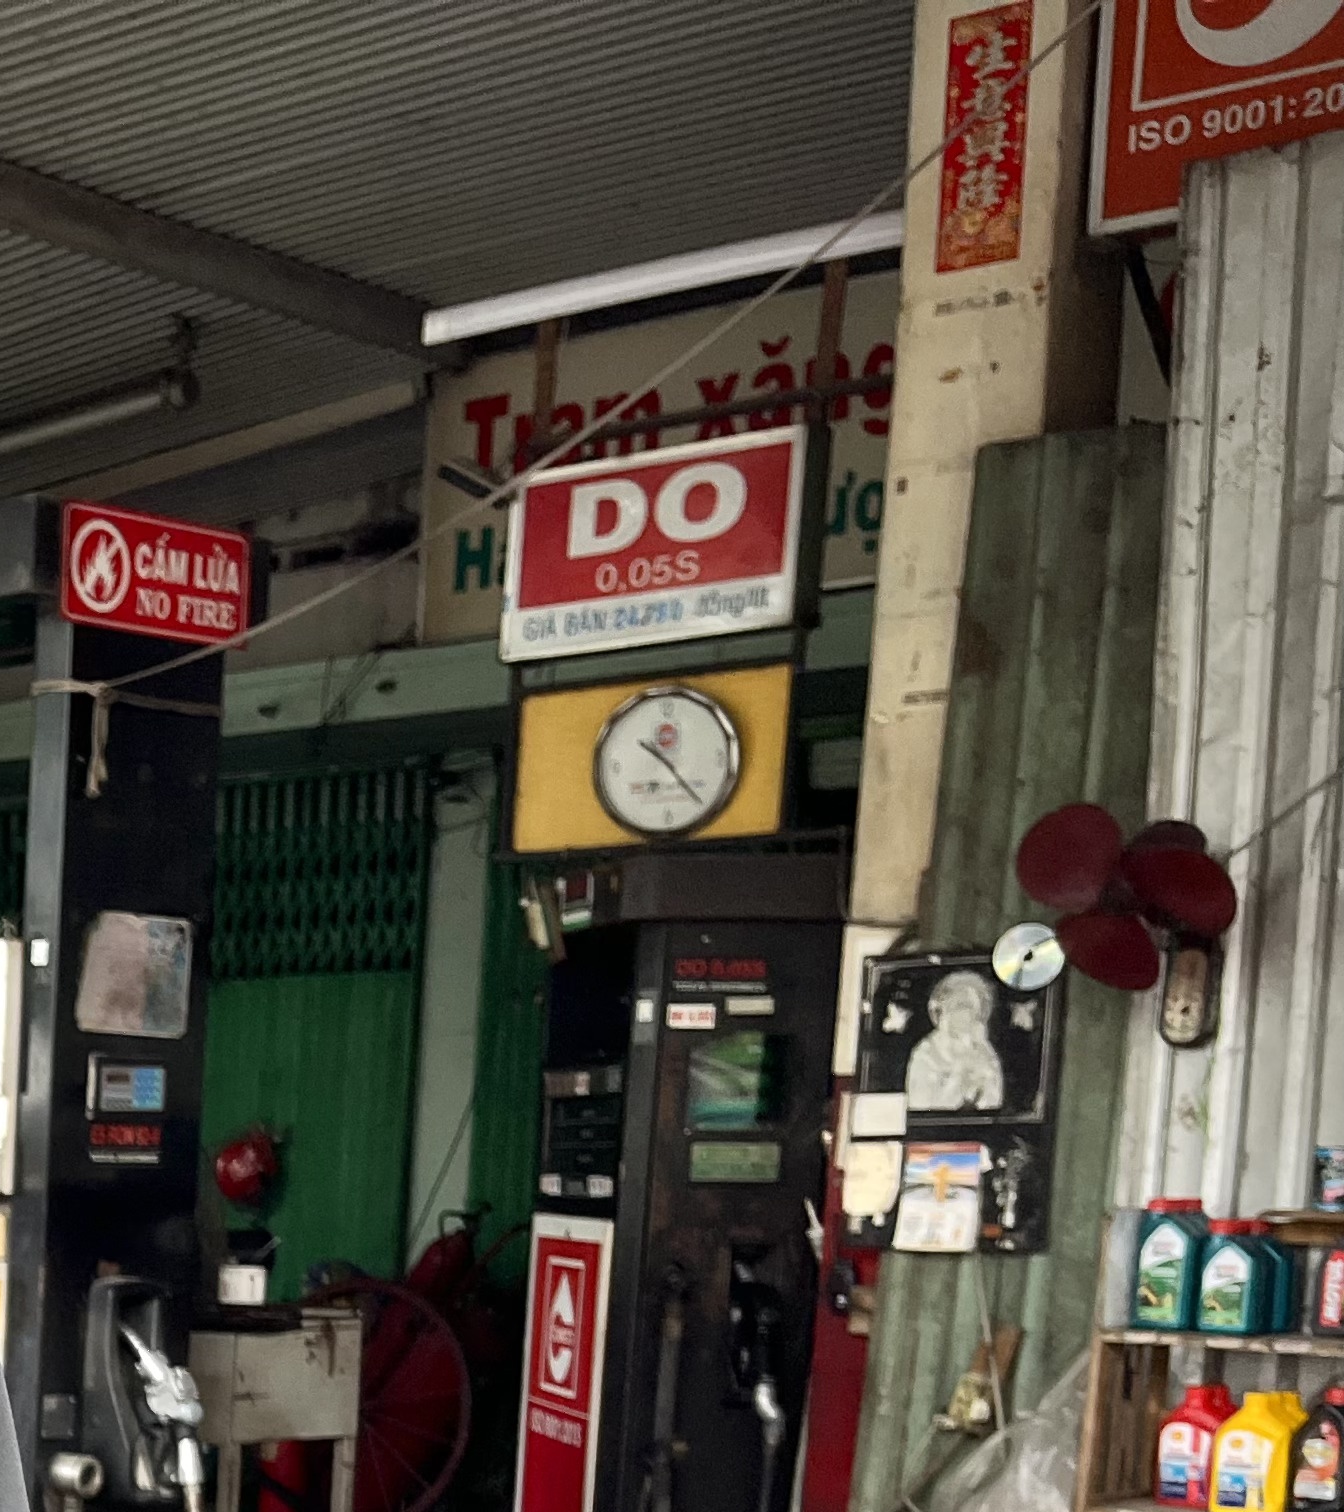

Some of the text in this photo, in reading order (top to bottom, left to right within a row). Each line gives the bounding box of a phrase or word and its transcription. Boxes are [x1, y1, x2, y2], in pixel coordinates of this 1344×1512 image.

[1128, 82, 1344, 155] ISO 9001:20
[566, 461, 748, 560] DO
[134, 532, 240, 596] CẤM LỬA
[594, 550, 701, 594] 0.05S
[135, 586, 237, 631] NO FIRE
